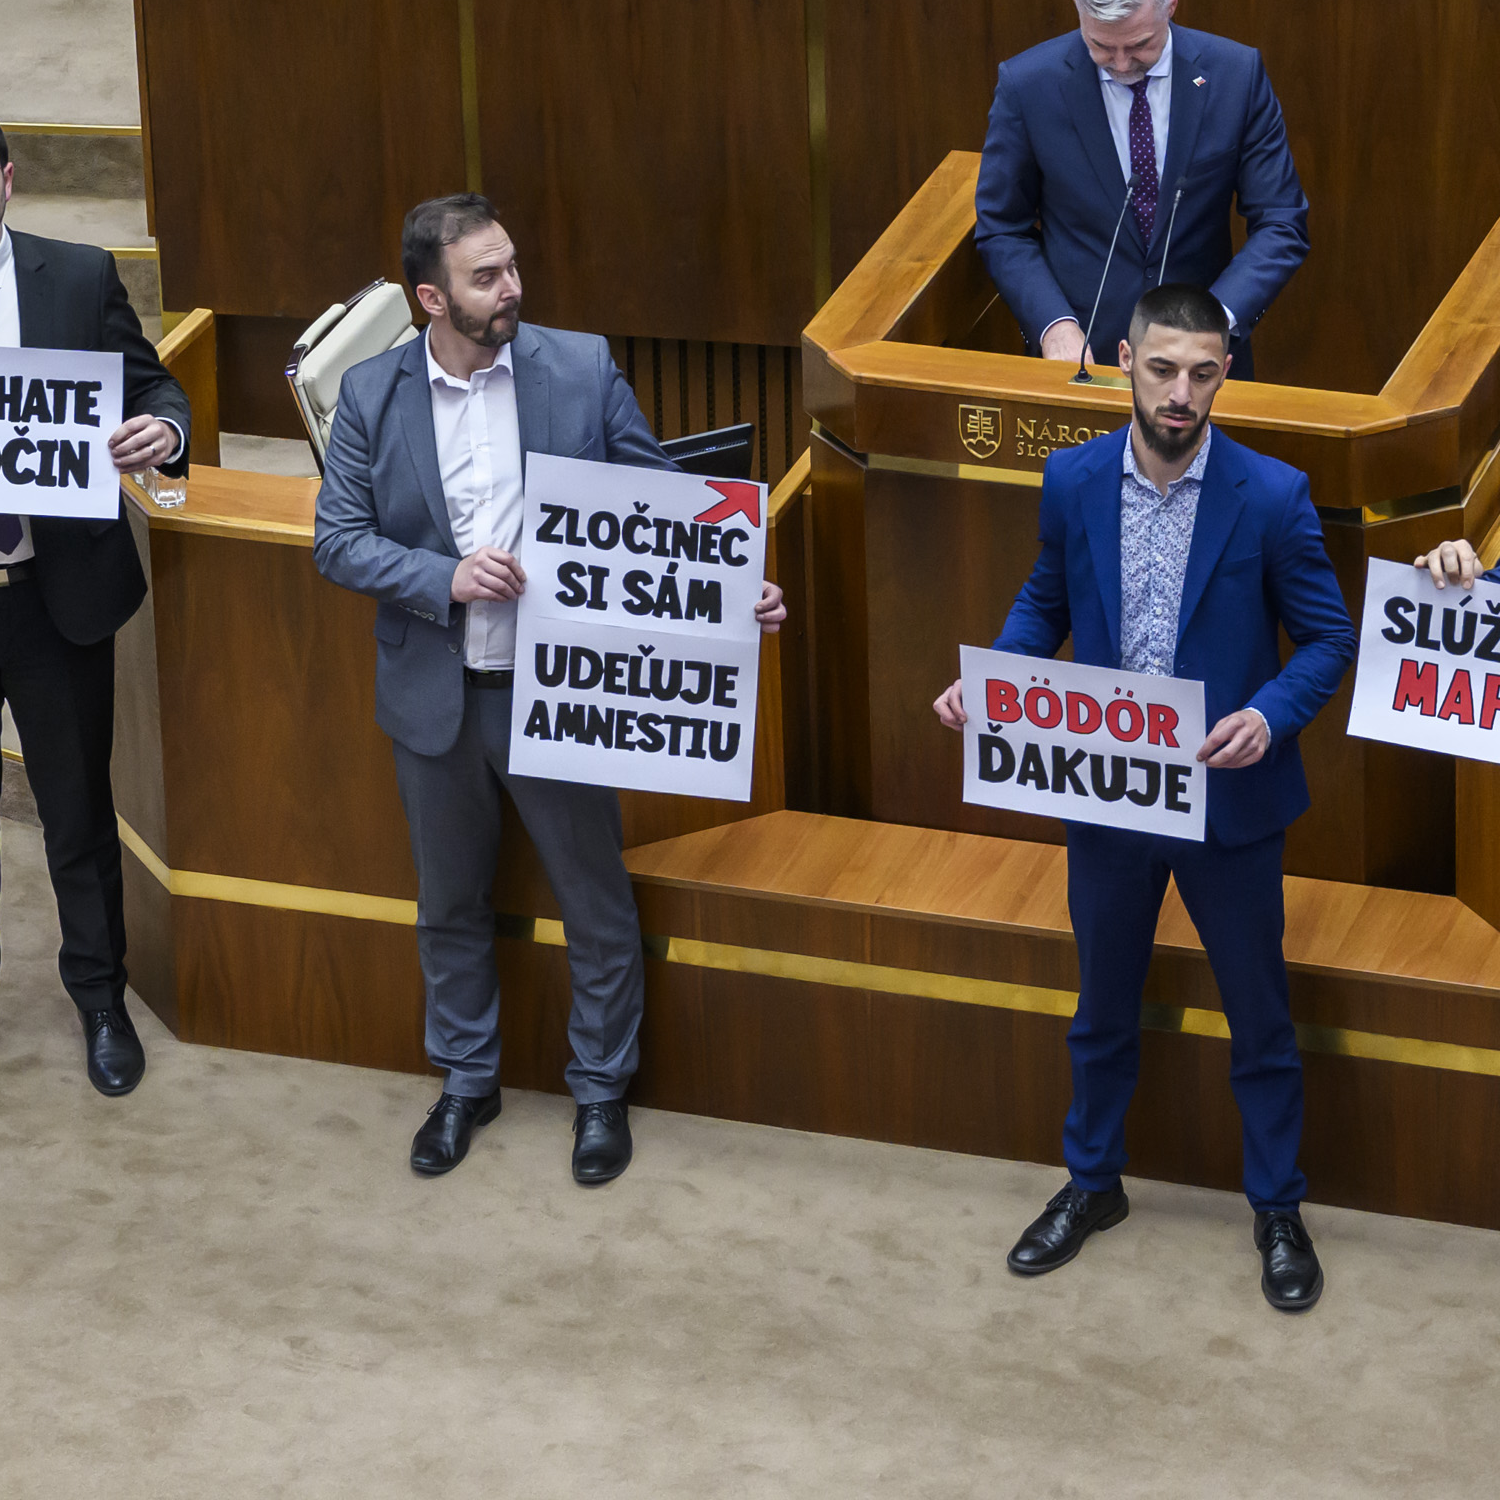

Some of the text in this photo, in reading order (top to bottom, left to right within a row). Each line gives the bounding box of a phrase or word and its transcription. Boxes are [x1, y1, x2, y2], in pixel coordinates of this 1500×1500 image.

[536, 501, 749, 566] ZLOČINEC
[555, 561, 722, 623] SI SÁM
[535, 643, 739, 708] UDEĽUJE
[524, 700, 740, 762] AMNESTIU
[986, 675, 1180, 748] BÖDÖR
[978, 722, 1192, 813] ĎAKUJE
